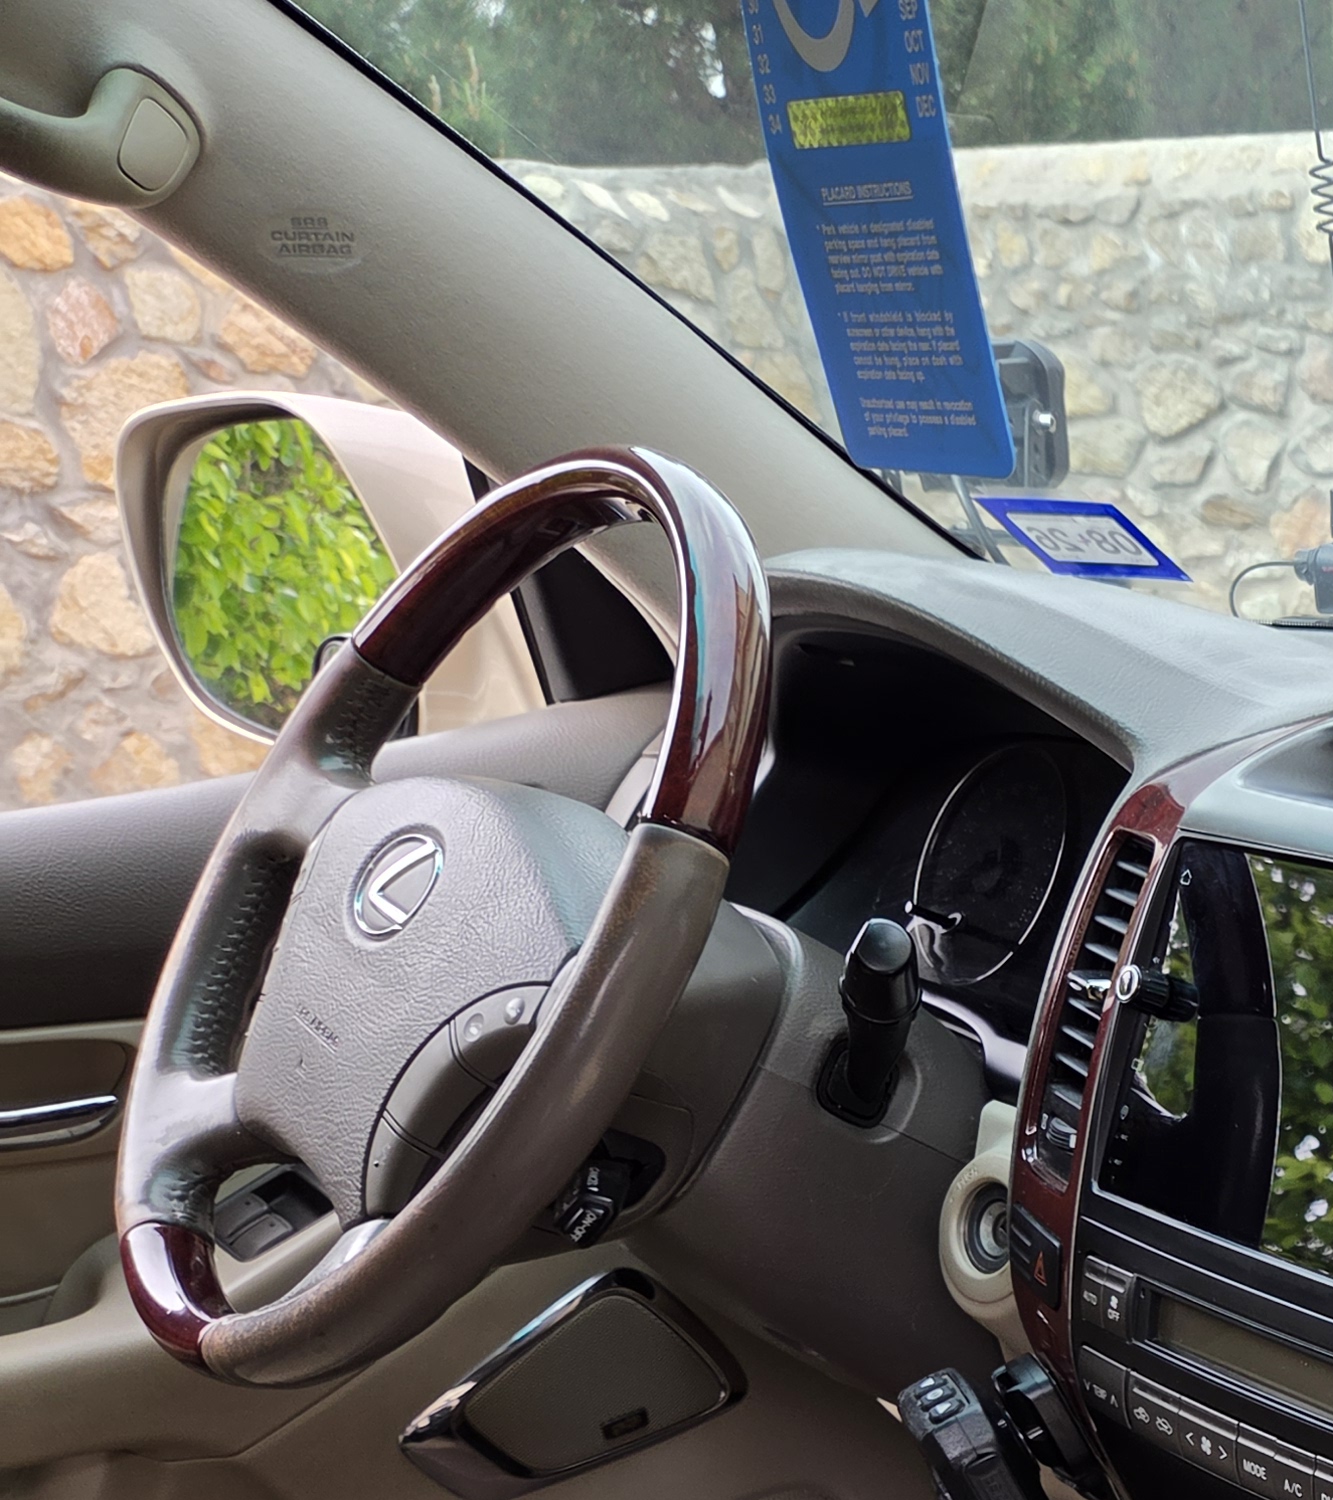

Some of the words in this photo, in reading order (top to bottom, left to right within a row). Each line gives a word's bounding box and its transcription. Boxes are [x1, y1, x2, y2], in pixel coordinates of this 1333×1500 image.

[898, 0, 918, 20] SEP
[752, 24, 764, 45] 31
[904, 29, 925, 53] OCT
[757, 54, 771, 75] 32
[909, 62, 930, 85] NOV
[762, 84, 776, 105] 33
[915, 95, 936, 118] DEC
[768, 114, 783, 135] 34
[821, 187, 856, 201] PLACARD
[857, 181, 912, 199] INSTRUCTIONS
[271, 230, 355, 242] CURTAIN
[279, 243, 353, 255] AIRBAG
[1107, 1308, 1121, 1322] OFF
[1242, 1458, 1267, 1481] MODE
[1283, 1479, 1303, 1498] A/C
